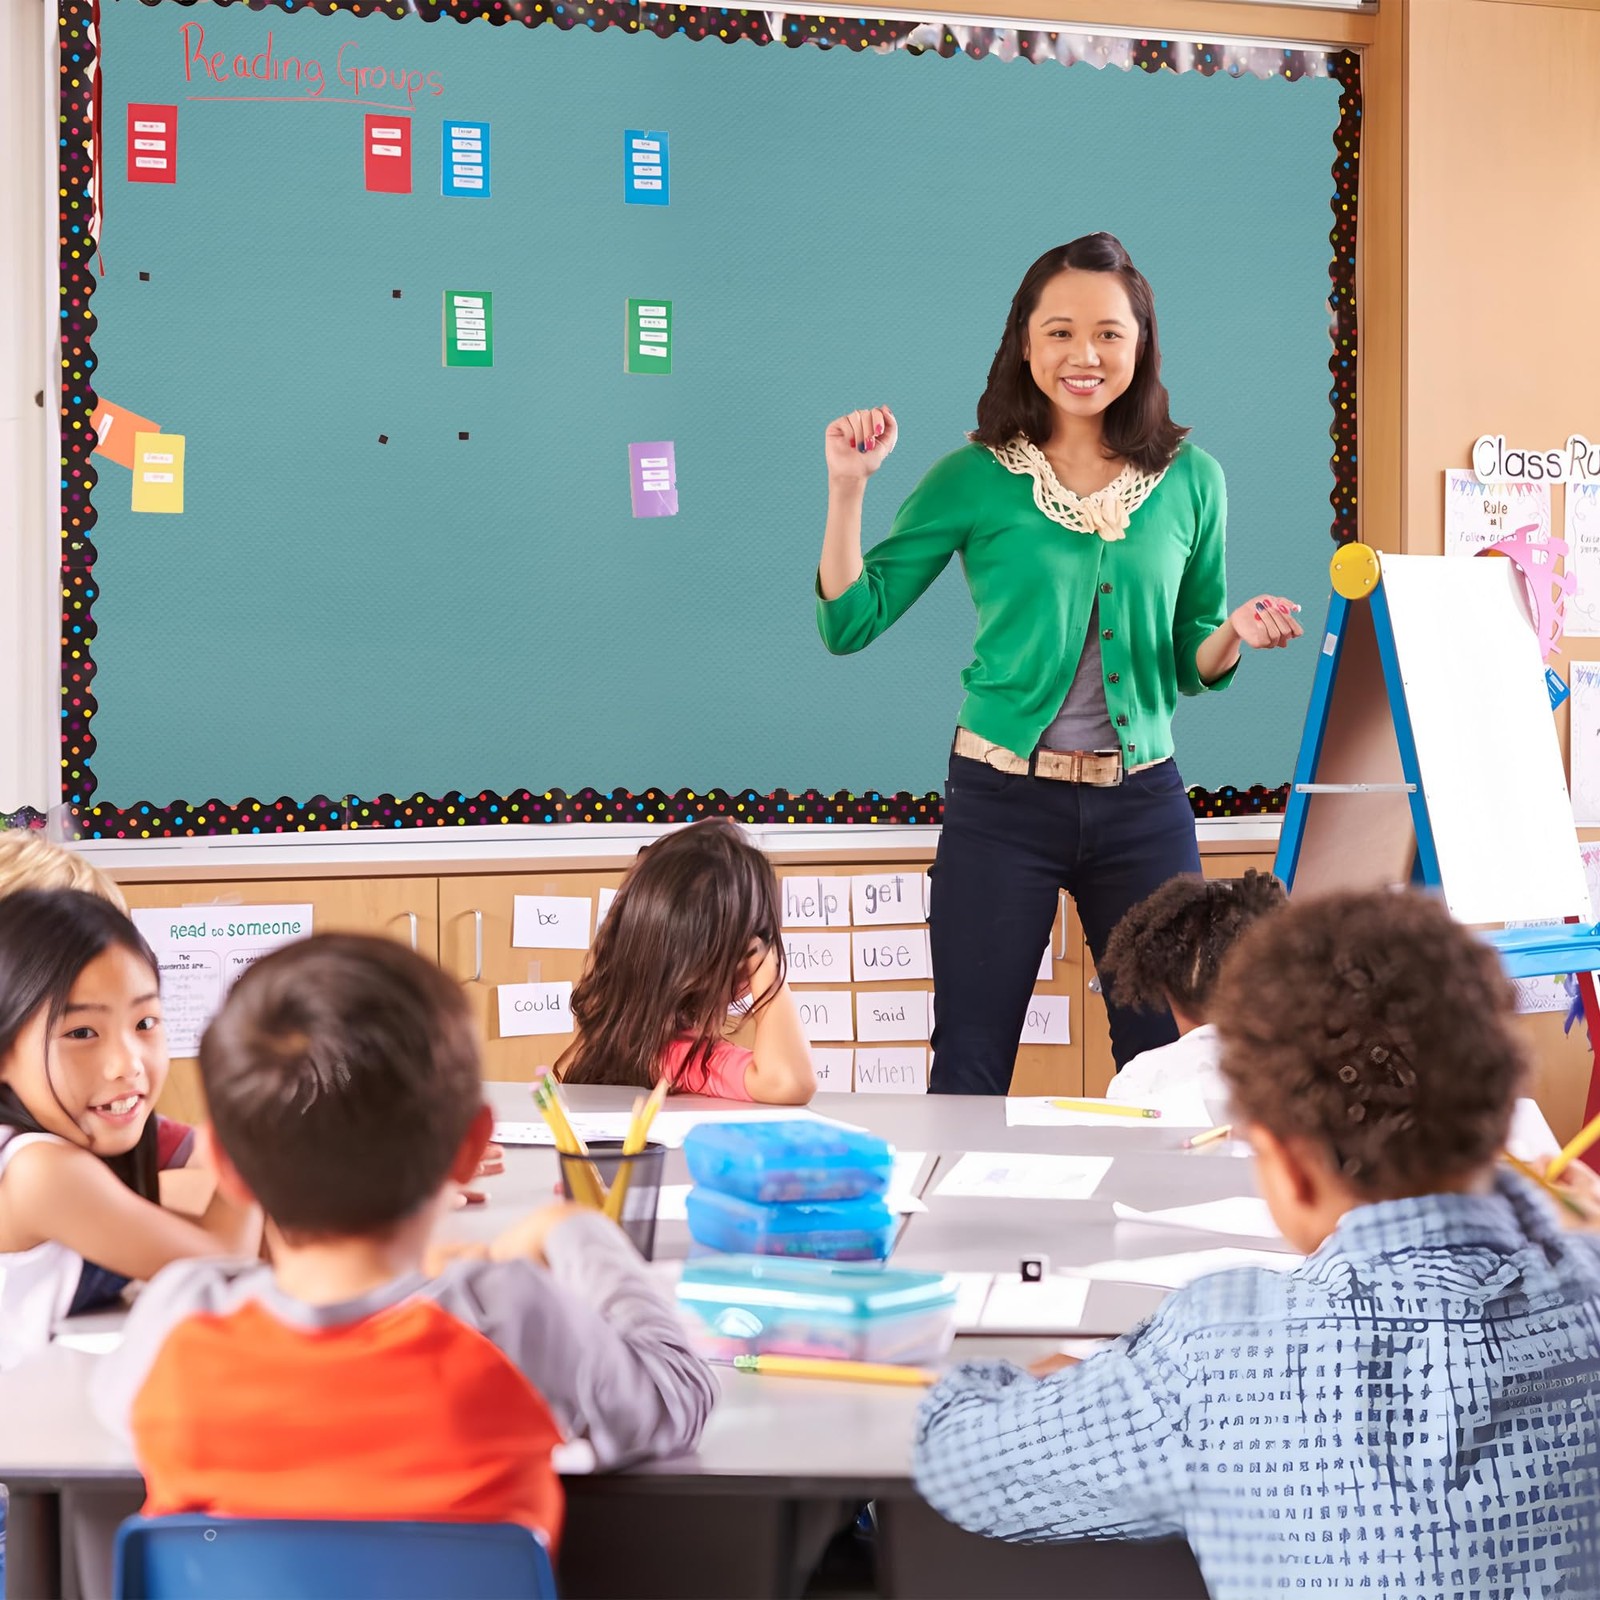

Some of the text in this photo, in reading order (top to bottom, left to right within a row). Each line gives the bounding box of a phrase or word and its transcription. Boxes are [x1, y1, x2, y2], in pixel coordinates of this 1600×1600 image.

[179, 21, 444, 106] Reading Groups
[1478, 437, 1562, 479] Class
[1483, 500, 1508, 515] Rule
[786, 879, 838, 926] help
[865, 875, 905, 914] get
[536, 908, 560, 926] be
[169, 921, 301, 940] Read to someone
[786, 942, 834, 970] take
[863, 945, 912, 968] use
[514, 994, 561, 1013] could
[873, 1006, 906, 1022] said
[858, 1058, 915, 1084] when
